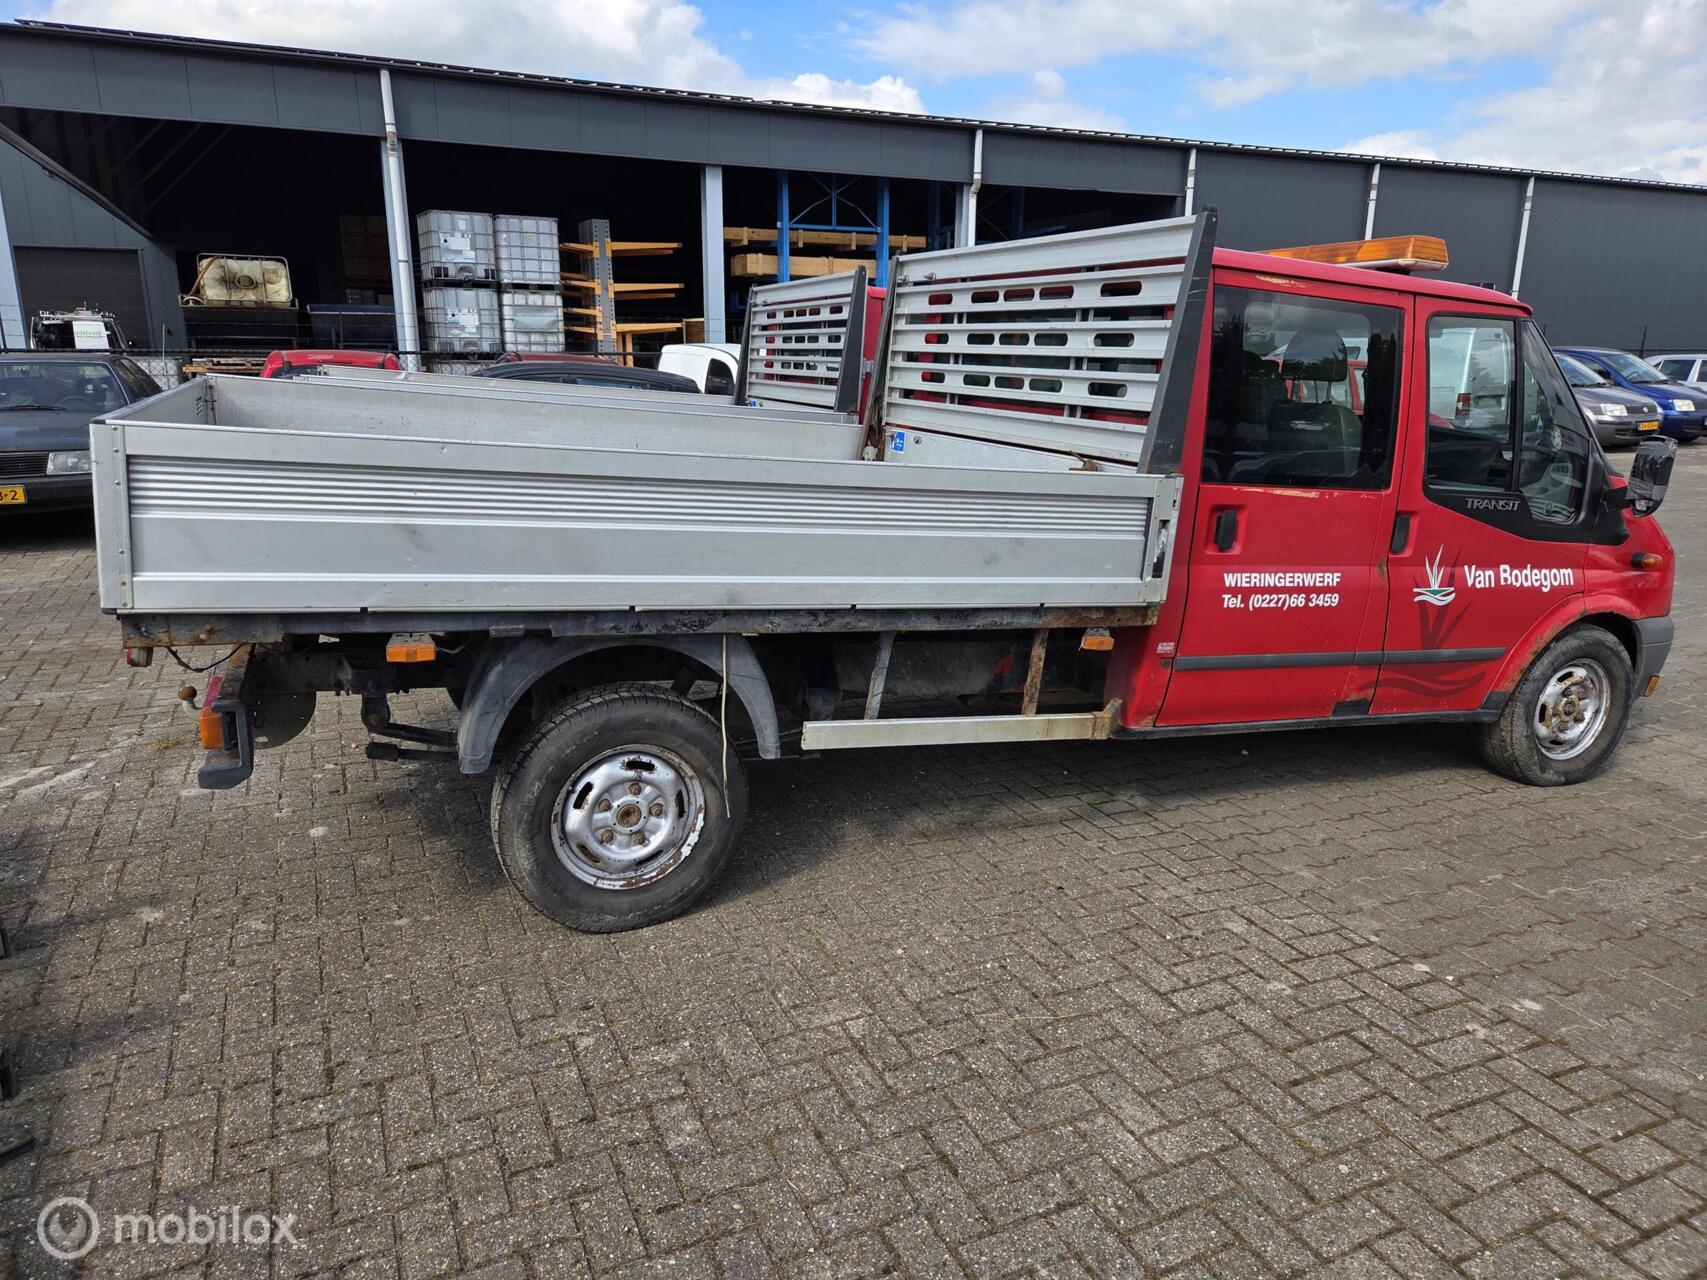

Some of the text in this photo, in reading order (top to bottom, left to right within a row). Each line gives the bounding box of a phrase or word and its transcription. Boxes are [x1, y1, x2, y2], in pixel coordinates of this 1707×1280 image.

[1465, 498, 1521, 511] TRANSIT
[1223, 572, 1341, 588] WIERINGERWERF
[1463, 563, 1574, 592] Van Bodegom
[1222, 593, 1340, 611] Tel. (0227)66 3459
